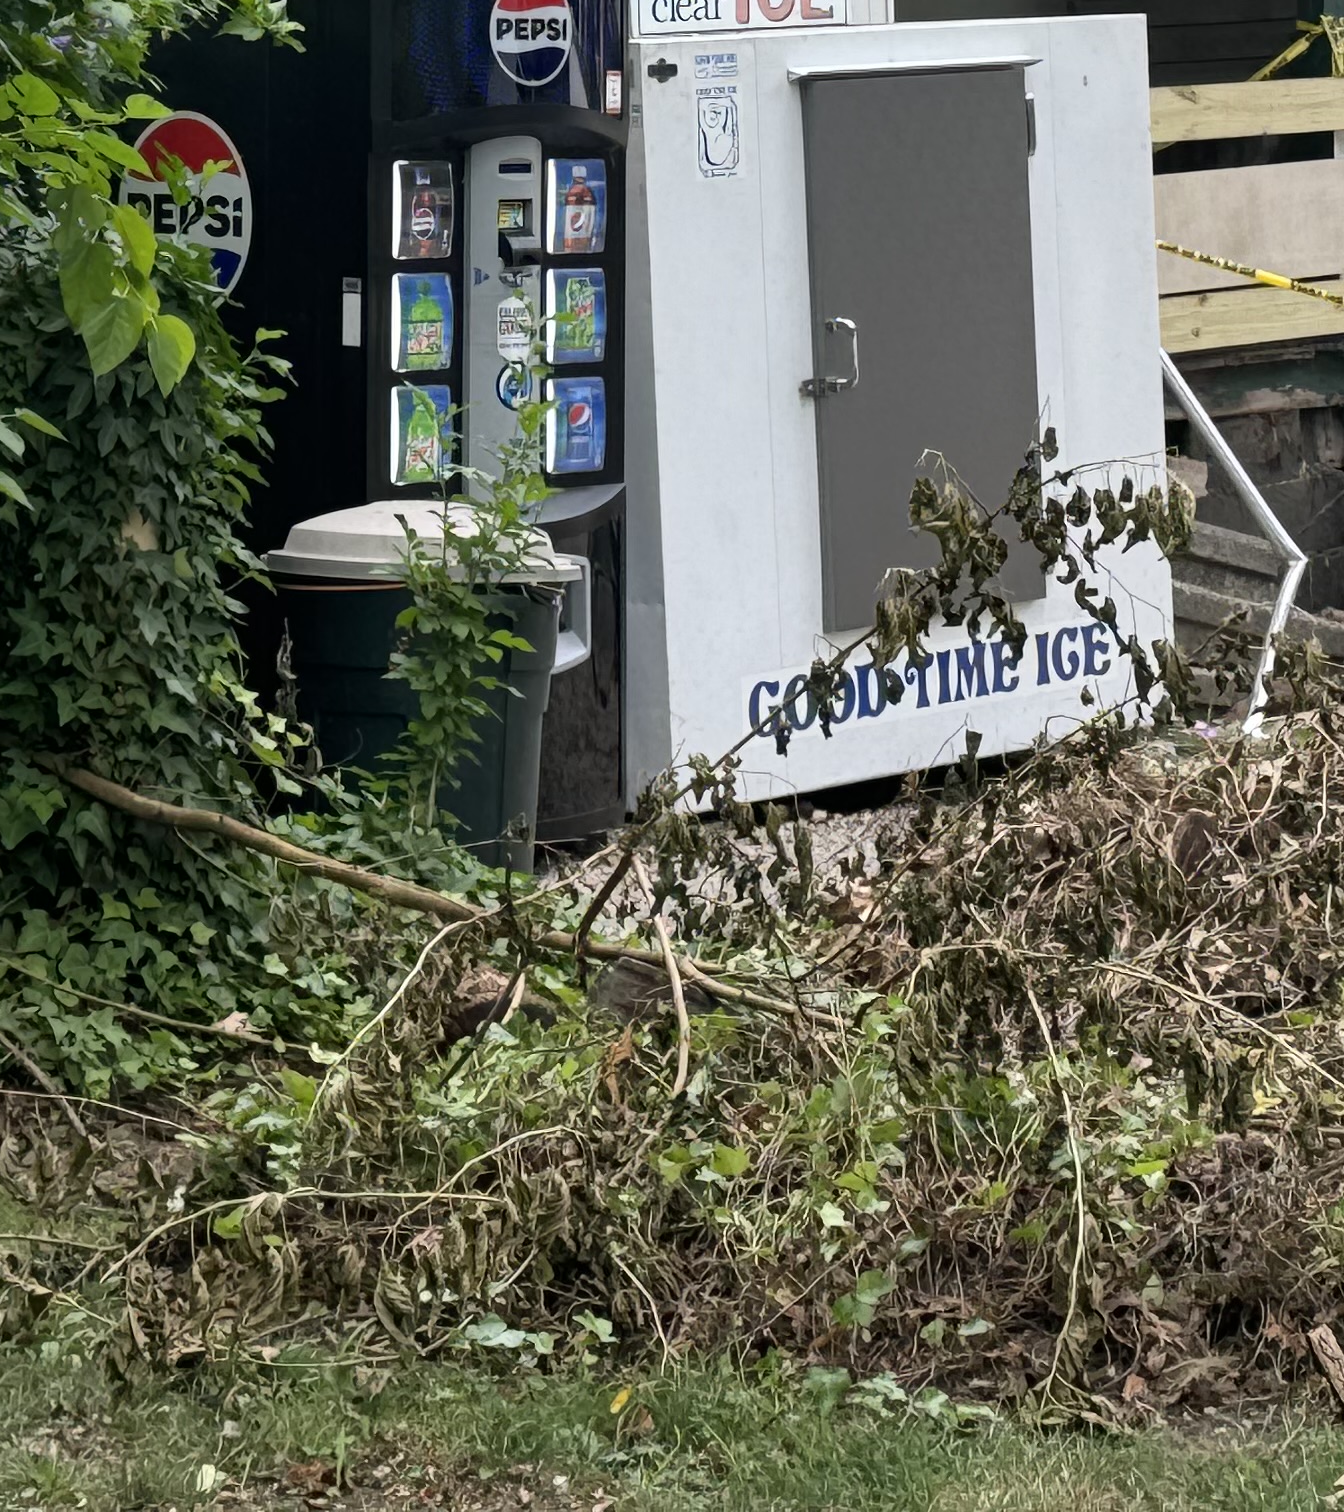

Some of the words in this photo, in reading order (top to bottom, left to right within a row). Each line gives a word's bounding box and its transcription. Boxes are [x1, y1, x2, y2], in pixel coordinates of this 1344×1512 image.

[496, 17, 567, 42] PEPSI
[748, 662, 888, 738] GOOD
[905, 640, 1020, 709] TIME
[1035, 621, 1112, 686] ICE
